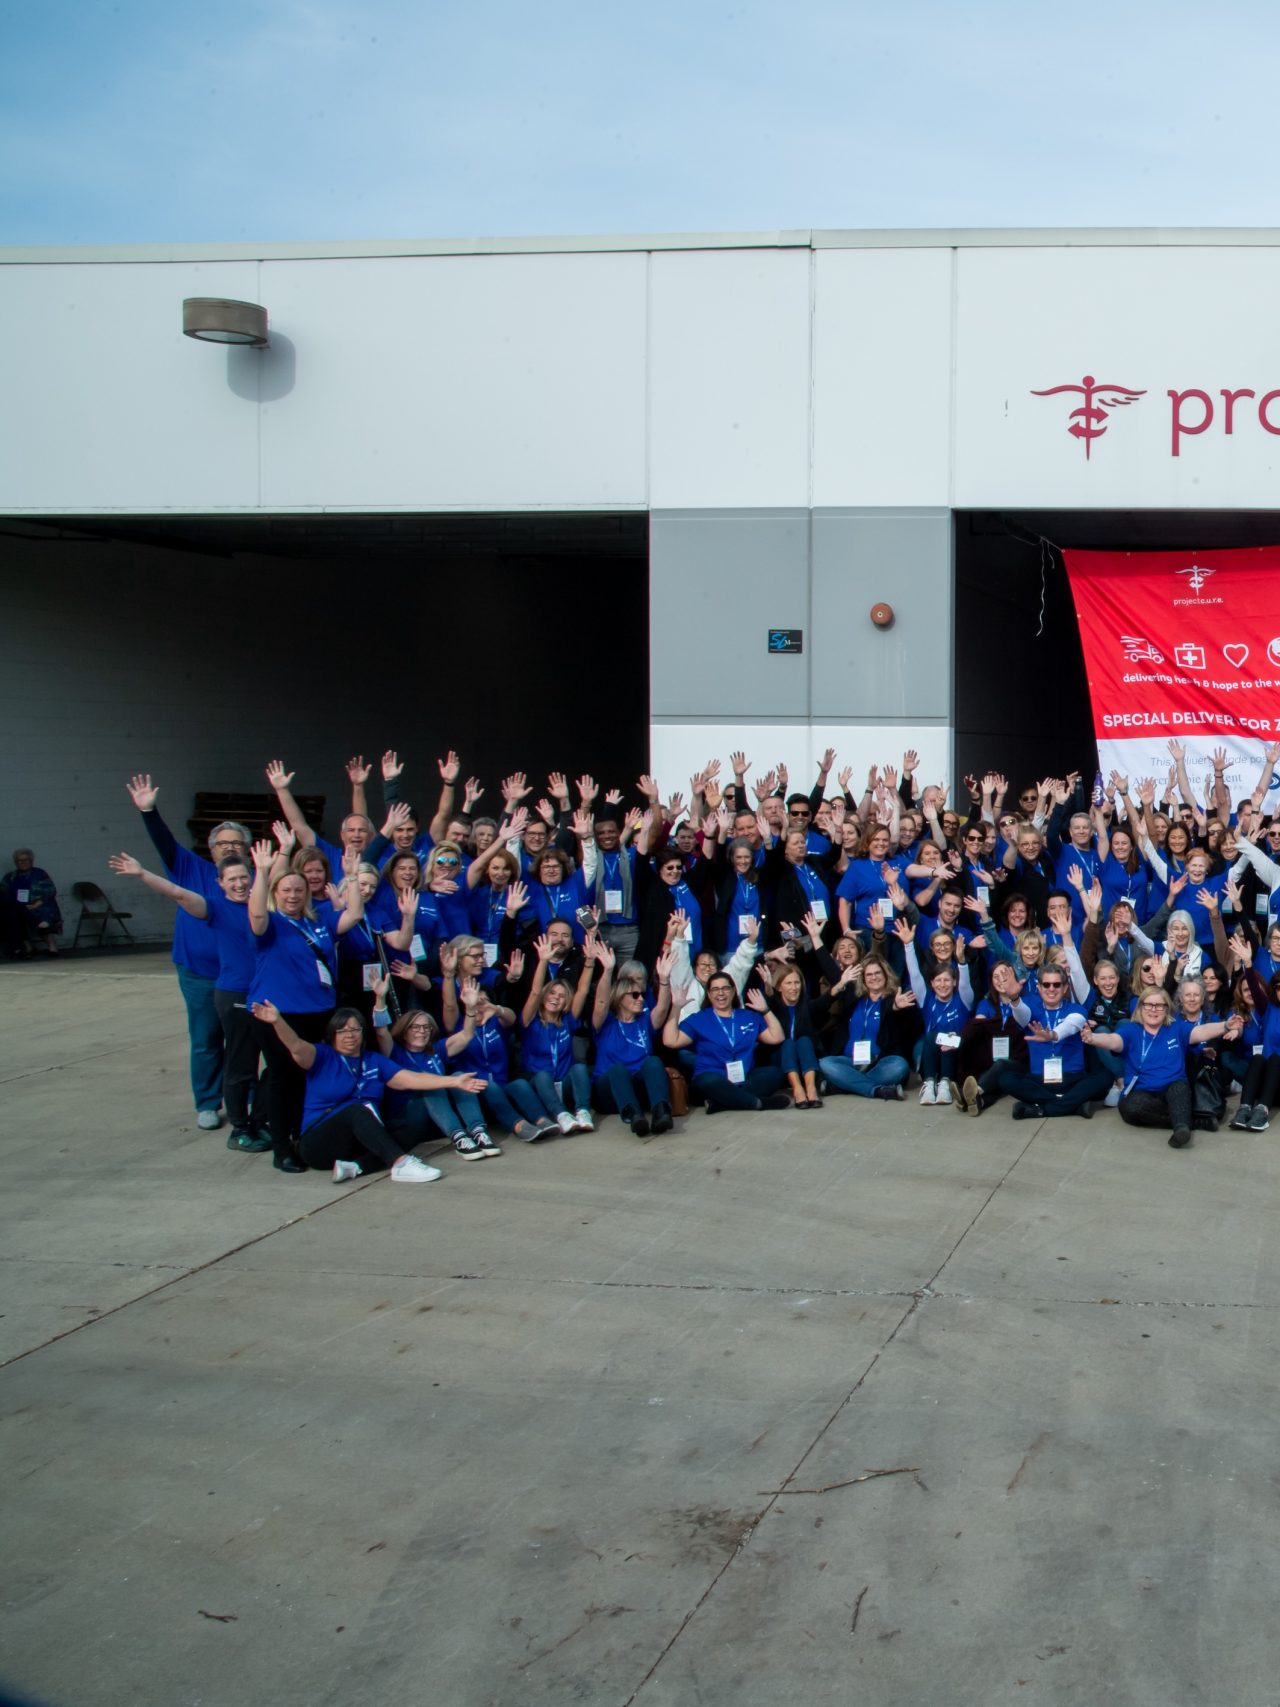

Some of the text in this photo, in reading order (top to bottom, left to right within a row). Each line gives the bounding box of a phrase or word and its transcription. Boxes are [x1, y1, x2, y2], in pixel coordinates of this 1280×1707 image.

[1173, 597, 1224, 606] projectc.u.r.e.
[1123, 673, 1173, 684] delivering
[1212, 680, 1239, 691] hope
[1240, 680, 1252, 688] to
[1254, 679, 1272, 688] the
[1103, 712, 1170, 727] SPECIAL
[1172, 711, 1239, 727] DELIVER
[1239, 717, 1271, 731] FOR
[1150, 757, 1171, 767] This
